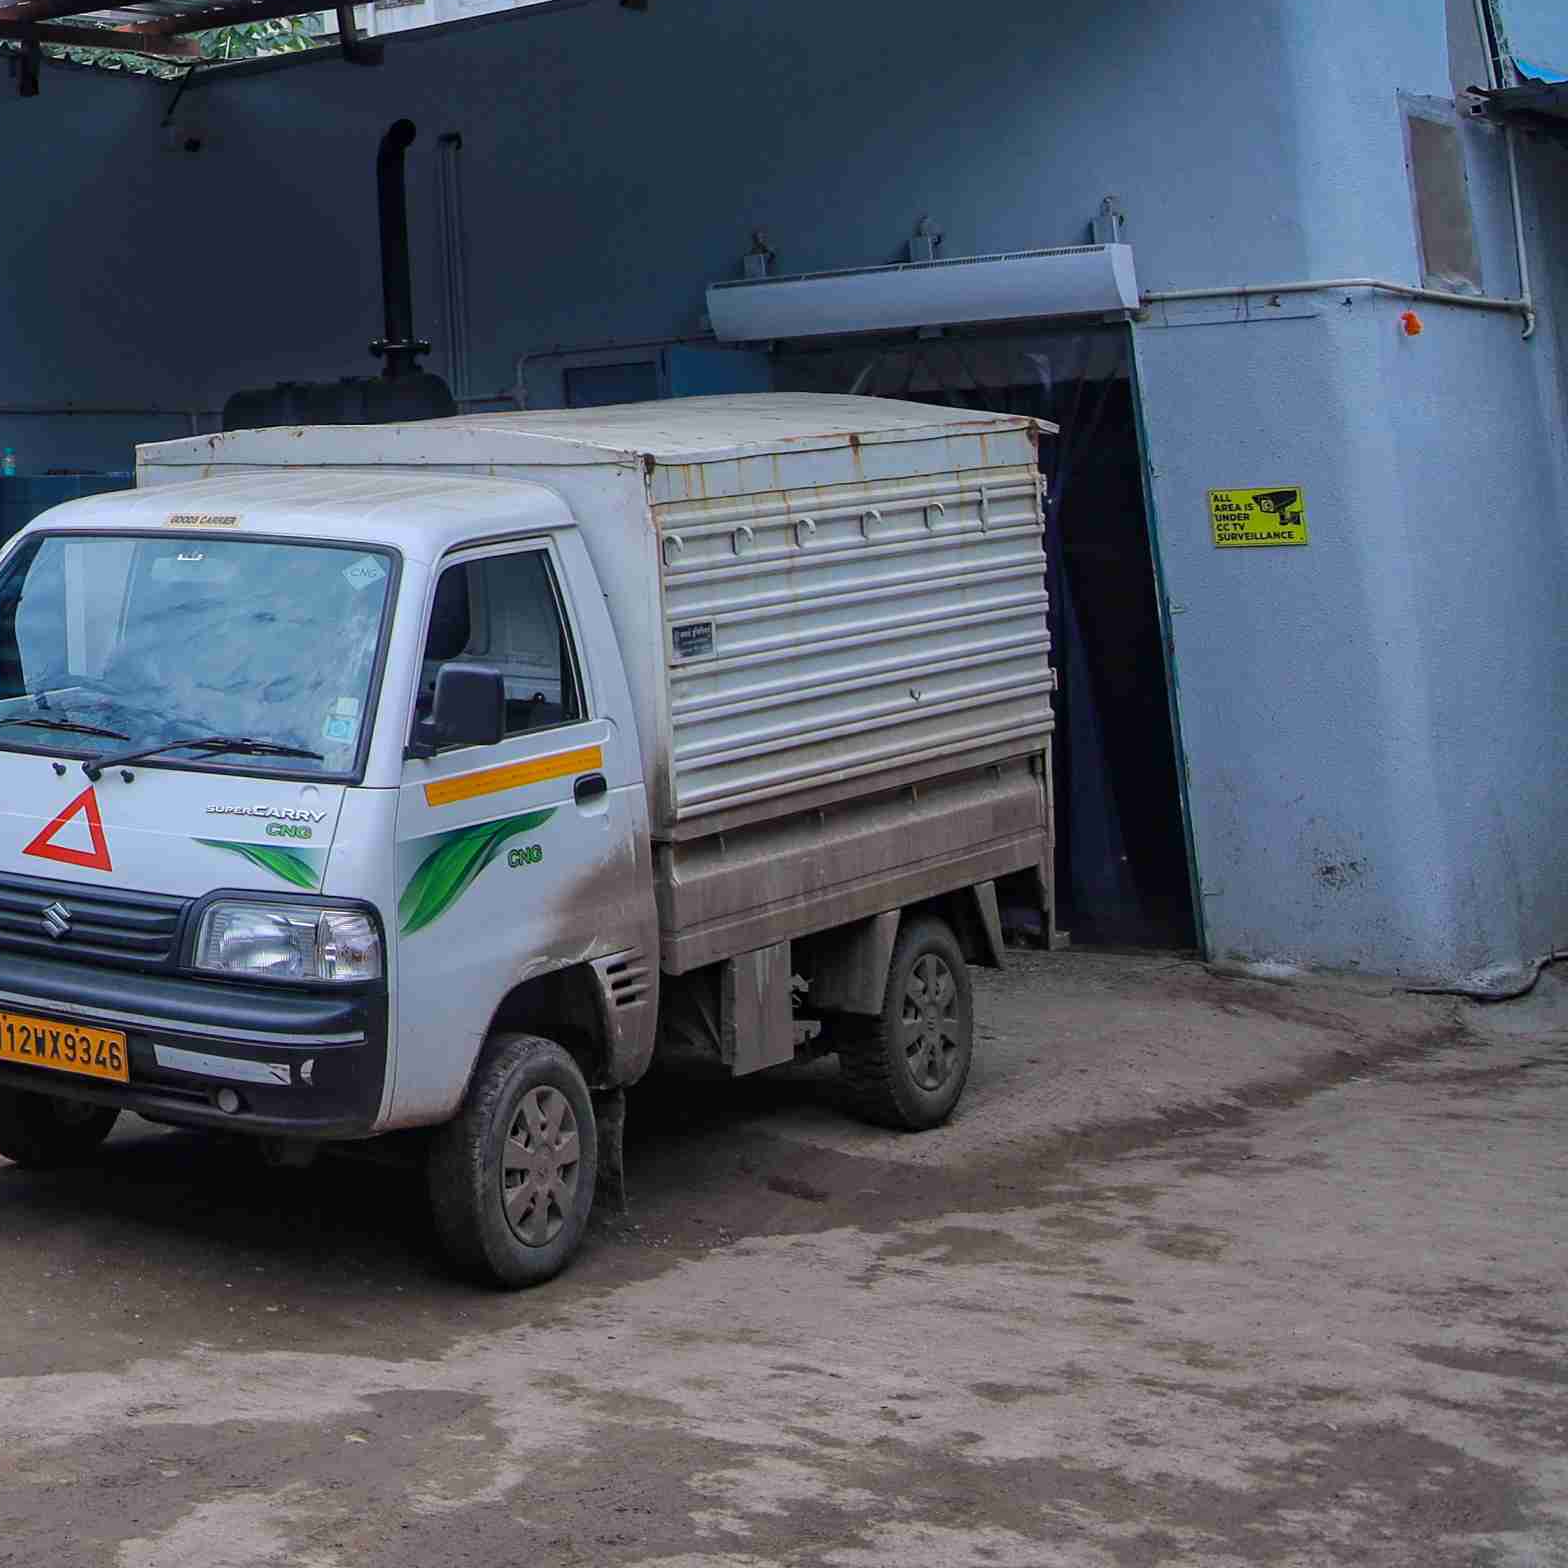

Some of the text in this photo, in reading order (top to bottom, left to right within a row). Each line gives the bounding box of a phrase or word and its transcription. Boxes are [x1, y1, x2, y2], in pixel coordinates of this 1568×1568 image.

[1213, 493, 1232, 502] ALL
[1214, 503, 1254, 512] AREA IS
[1215, 513, 1250, 522] UNDER
[1216, 522, 1245, 532] CC TV
[1216, 531, 1295, 542] SURVEILLANCE
[265, 822, 312, 840] CNG
[507, 843, 543, 868] CNG
